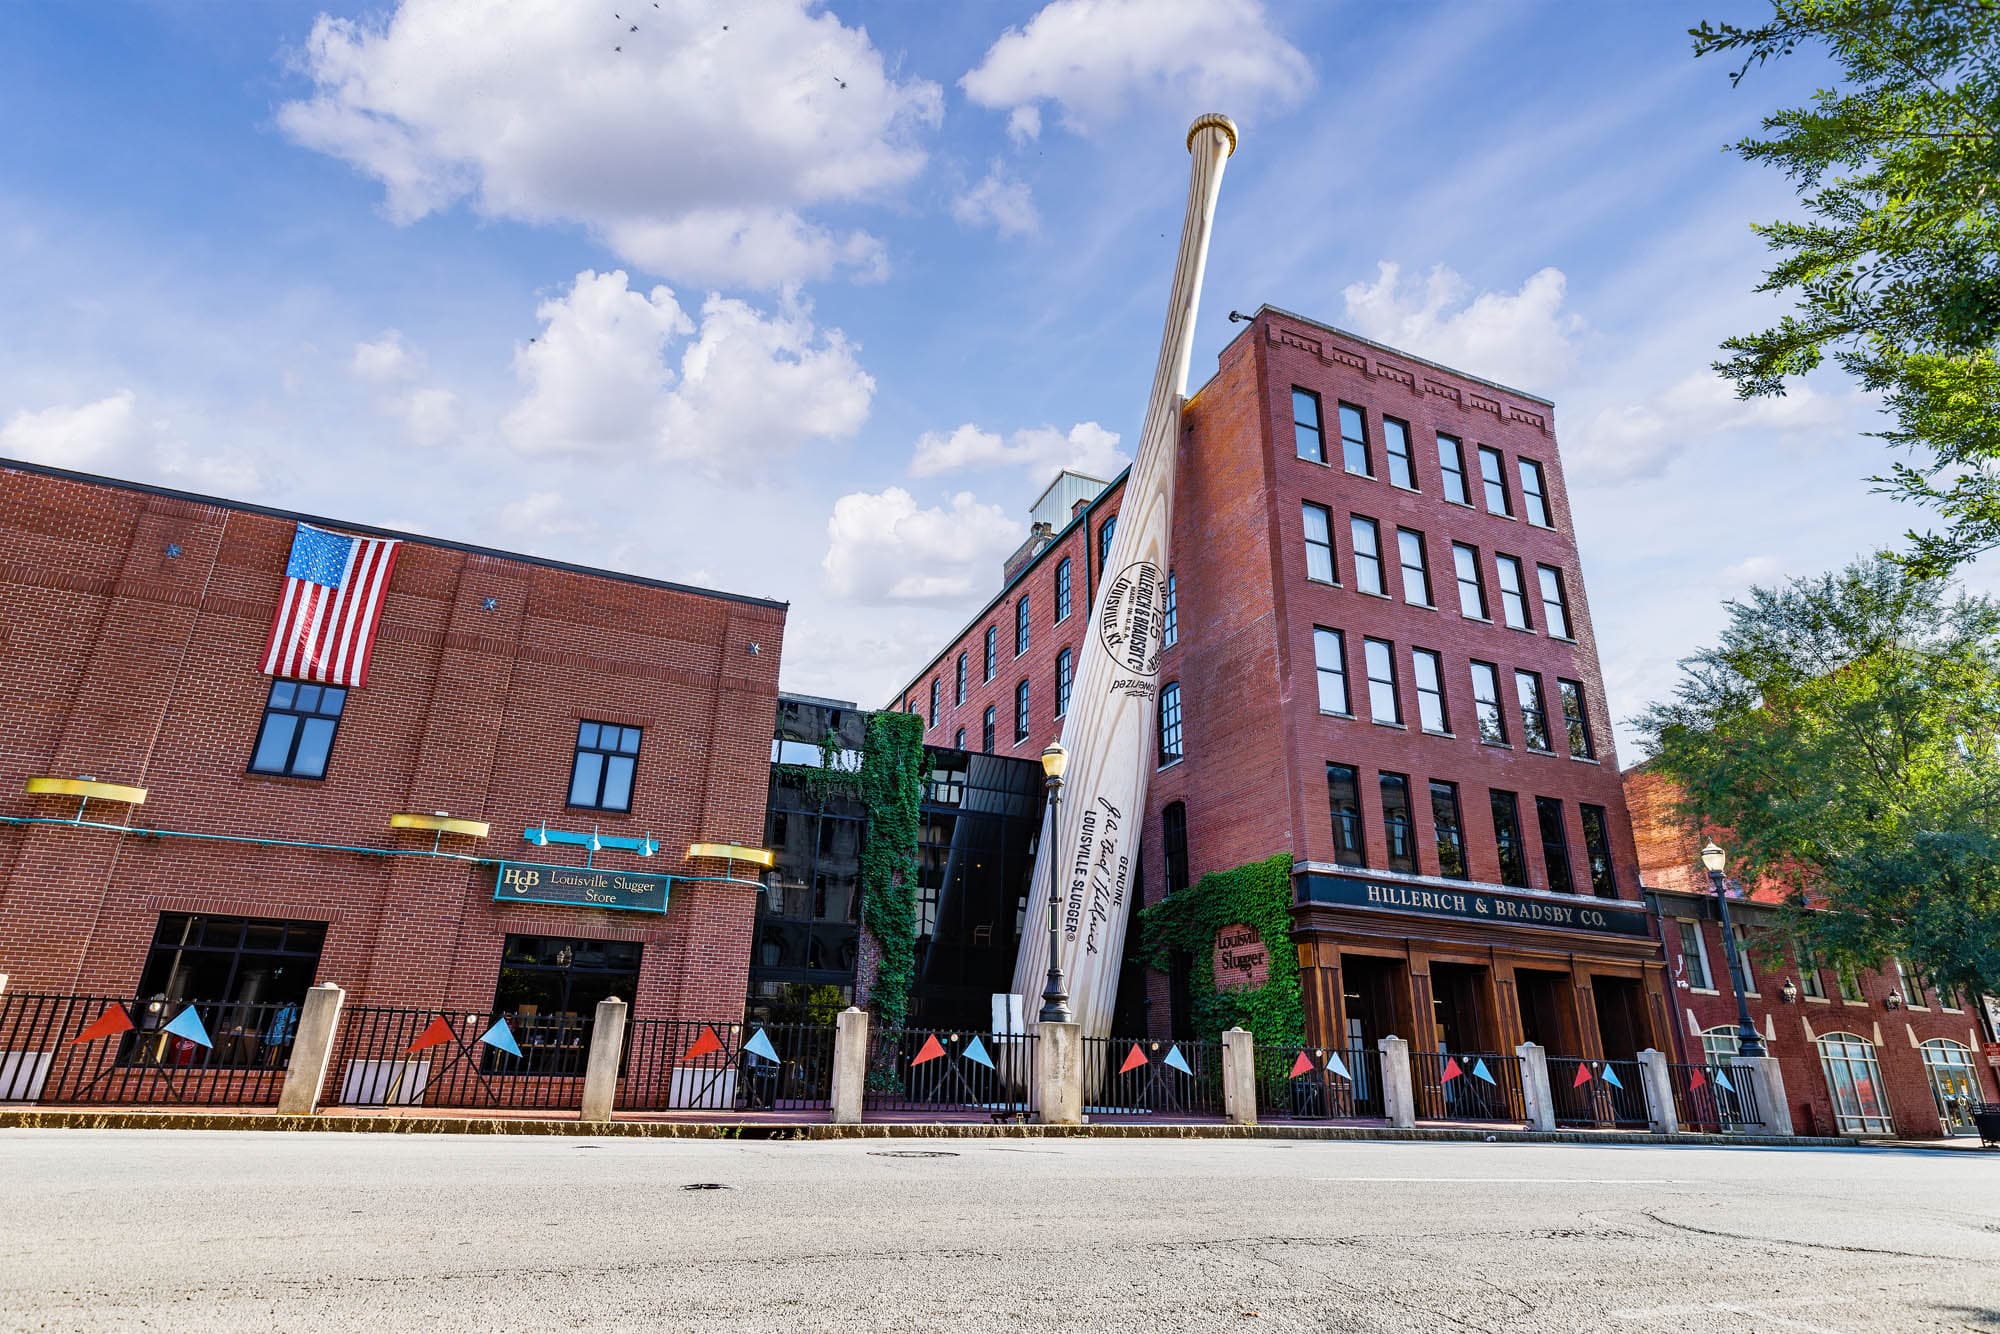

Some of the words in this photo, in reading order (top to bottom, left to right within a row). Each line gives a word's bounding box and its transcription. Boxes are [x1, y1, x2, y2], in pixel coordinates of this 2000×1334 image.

[1136, 565, 1156, 610] HILLERICH
[1127, 607, 1134, 615] IN
[1135, 608, 1150, 617] &
[1150, 606, 1162, 640] 125
[1129, 615, 1149, 660] BRADSBY
[1075, 810, 1097, 876] LOUISVILLE
[550, 871, 608, 888] Louisville
[613, 877, 656, 893] Slugger
[585, 889, 617, 903] Store
[1113, 855, 1129, 908] GENUINE
[1366, 885, 1466, 912] HILLERICH
[1475, 898, 1488, 914] &
[1495, 900, 1573, 923] BRADSBY
[1580, 910, 1607, 927] CO.
[1218, 925, 1259, 949] Louisvill
[1222, 950, 1265, 971] Slugger
